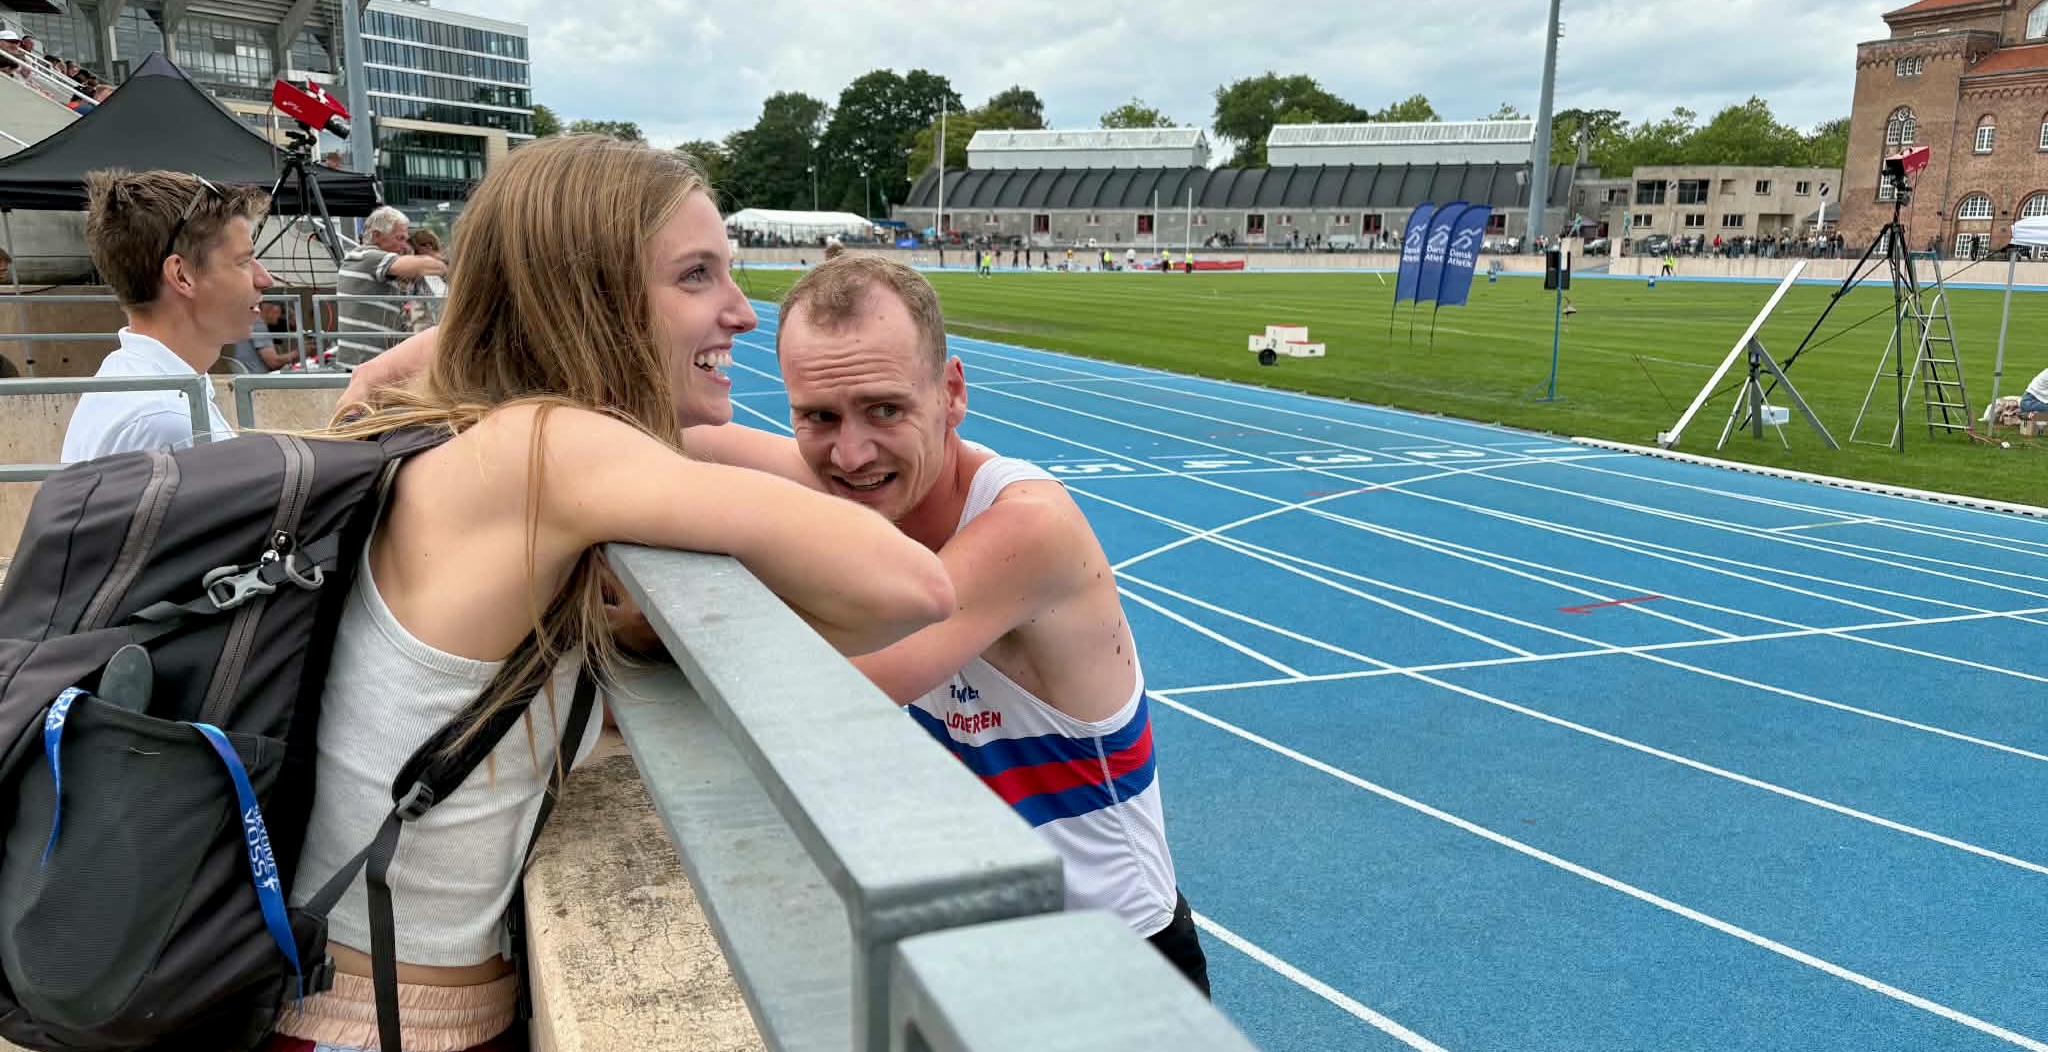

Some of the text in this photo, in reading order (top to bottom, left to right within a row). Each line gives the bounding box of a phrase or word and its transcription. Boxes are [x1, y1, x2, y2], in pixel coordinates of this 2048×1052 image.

[1450, 248, 1472, 260] Dansk
[1447, 257, 1473, 267] Atletik
[1296, 454, 1373, 463] 3
[1404, 449, 1485, 458] 2
[1048, 463, 1136, 473] 5
[1182, 460, 1251, 469] 4
[245, 807, 266, 876] VOSS
